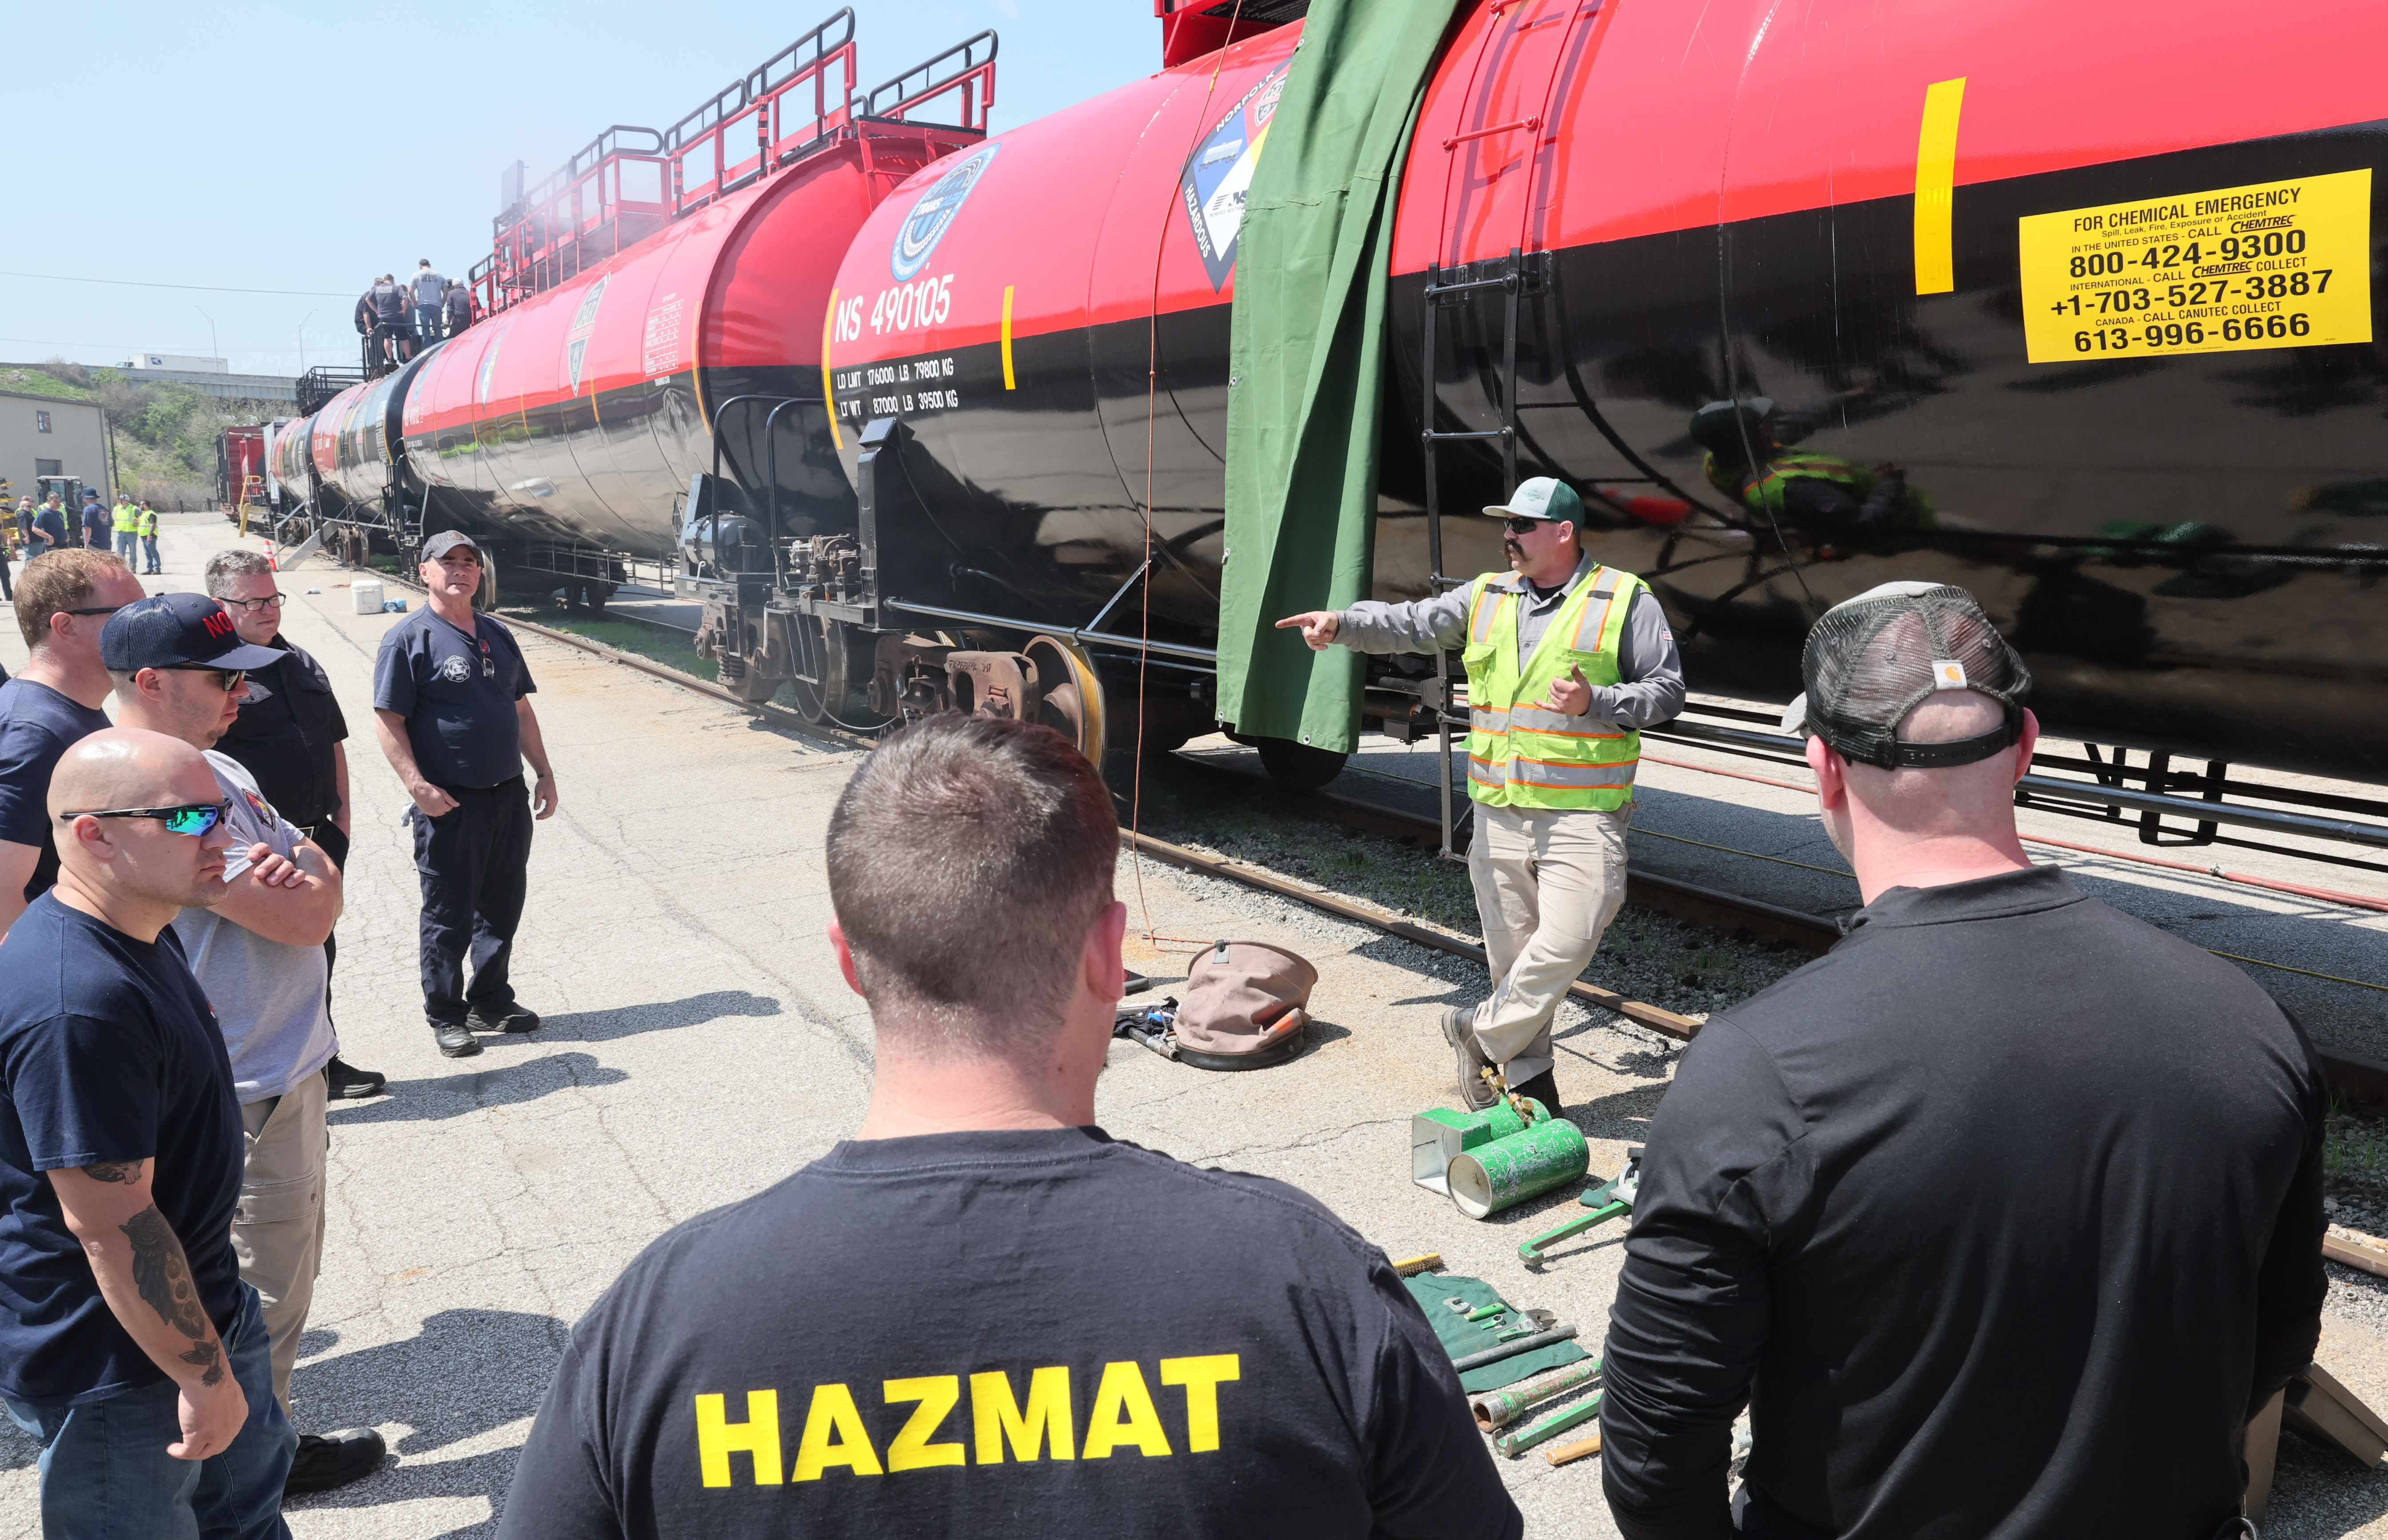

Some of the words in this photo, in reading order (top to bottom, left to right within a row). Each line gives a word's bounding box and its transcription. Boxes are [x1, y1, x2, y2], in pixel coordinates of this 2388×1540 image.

[1216, 70, 1274, 132] NORFOLK
[1185, 183, 1211, 259] HAZARDOUS
[2075, 216, 2103, 232] FOR
[2109, 204, 2189, 227] CHEMICAL
[2196, 188, 2301, 216] EMERGENCY
[2102, 229, 2121, 238] Spill,
[2124, 224, 2146, 234] Leak,
[2149, 222, 2167, 231] Fire,
[2171, 218, 2211, 229] Exposure
[2227, 210, 2267, 221] Accident
[2070, 229, 2305, 278] 800-424-9300
[2084, 243, 2101, 251] THE
[2104, 238, 2139, 249] UNITED
[2142, 233, 2178, 244] STATES
[2188, 227, 2221, 239] CALL
[2231, 215, 2295, 234] CHEMTREC
[2051, 269, 2332, 315] +1-703-527-3887
[2071, 277, 2144, 291] INTERNATIONAL
[2153, 271, 2185, 282] CALL
[2192, 261, 2253, 278] CHEMTREC
[2256, 257, 2307, 271] COLLECT
[835, 295, 863, 343] NS
[870, 274, 954, 335] 490105
[2096, 317, 2134, 326] CANADA
[2143, 311, 2175, 322] CALL
[2179, 306, 2228, 319] CANUTEC
[2232, 301, 2281, 315] COLLECT
[2075, 313, 2310, 352] 613-996-6666
[837, 373, 846, 389] LD
[847, 371, 861, 388] LMT
[867, 366, 894, 386] 176000
[898, 364, 909, 381] LB
[914, 359, 939, 379] 79800
[942, 357, 954, 376] KG
[840, 401, 848, 417] LT
[849, 400, 861, 415] WT
[873, 396, 898, 414] 87000
[902, 395, 914, 411] LB
[918, 391, 944, 410] 39500
[945, 389, 958, 407] KG
[695, 1354, 1240, 1488] HAZMAT
